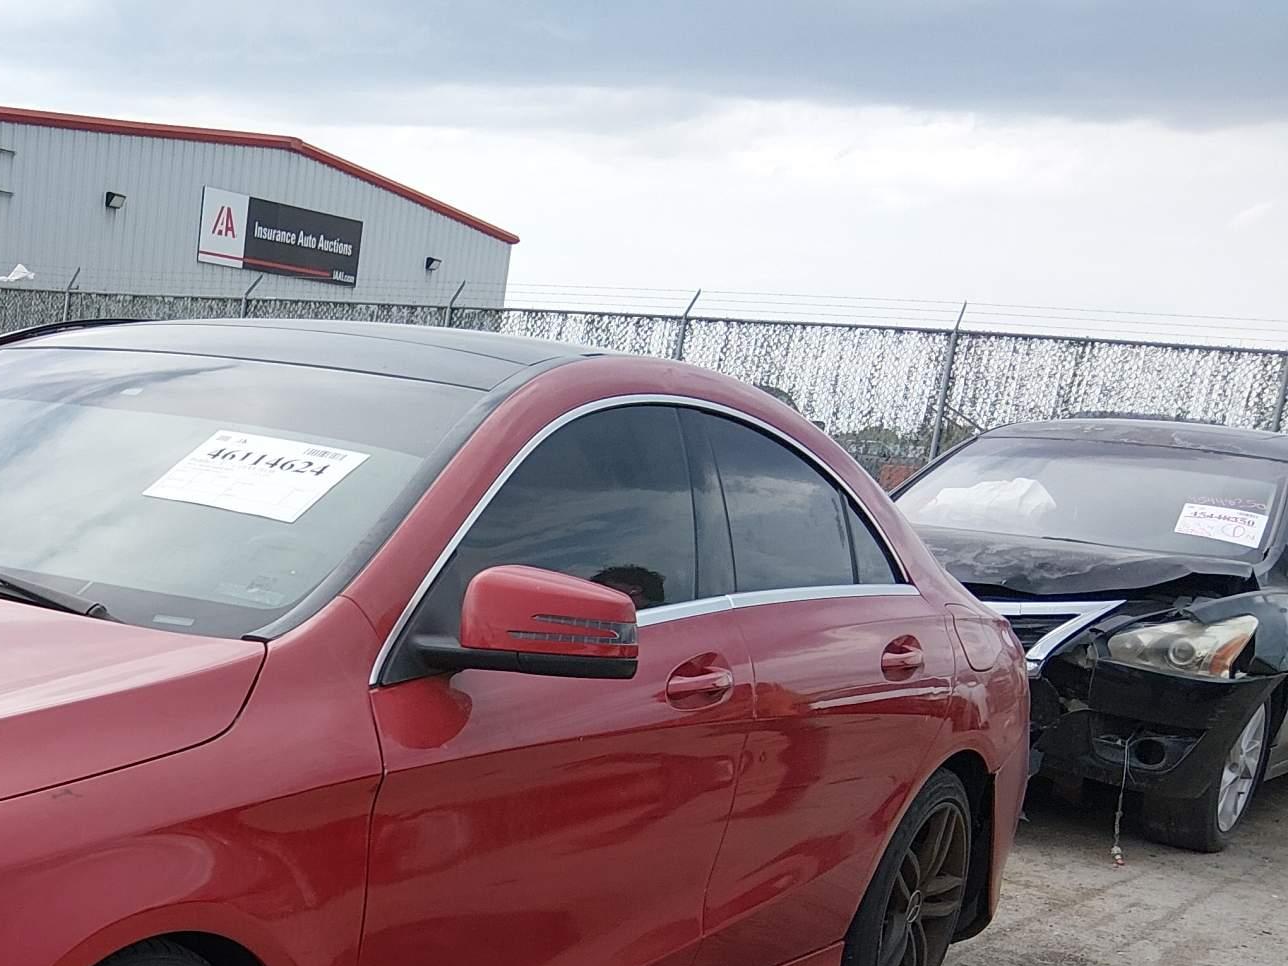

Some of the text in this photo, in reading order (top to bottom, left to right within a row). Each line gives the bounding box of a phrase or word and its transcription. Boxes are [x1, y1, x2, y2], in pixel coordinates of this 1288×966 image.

[253, 221, 353, 257] Insurance Auto Auctions
[207, 448, 331, 477] 46114624
